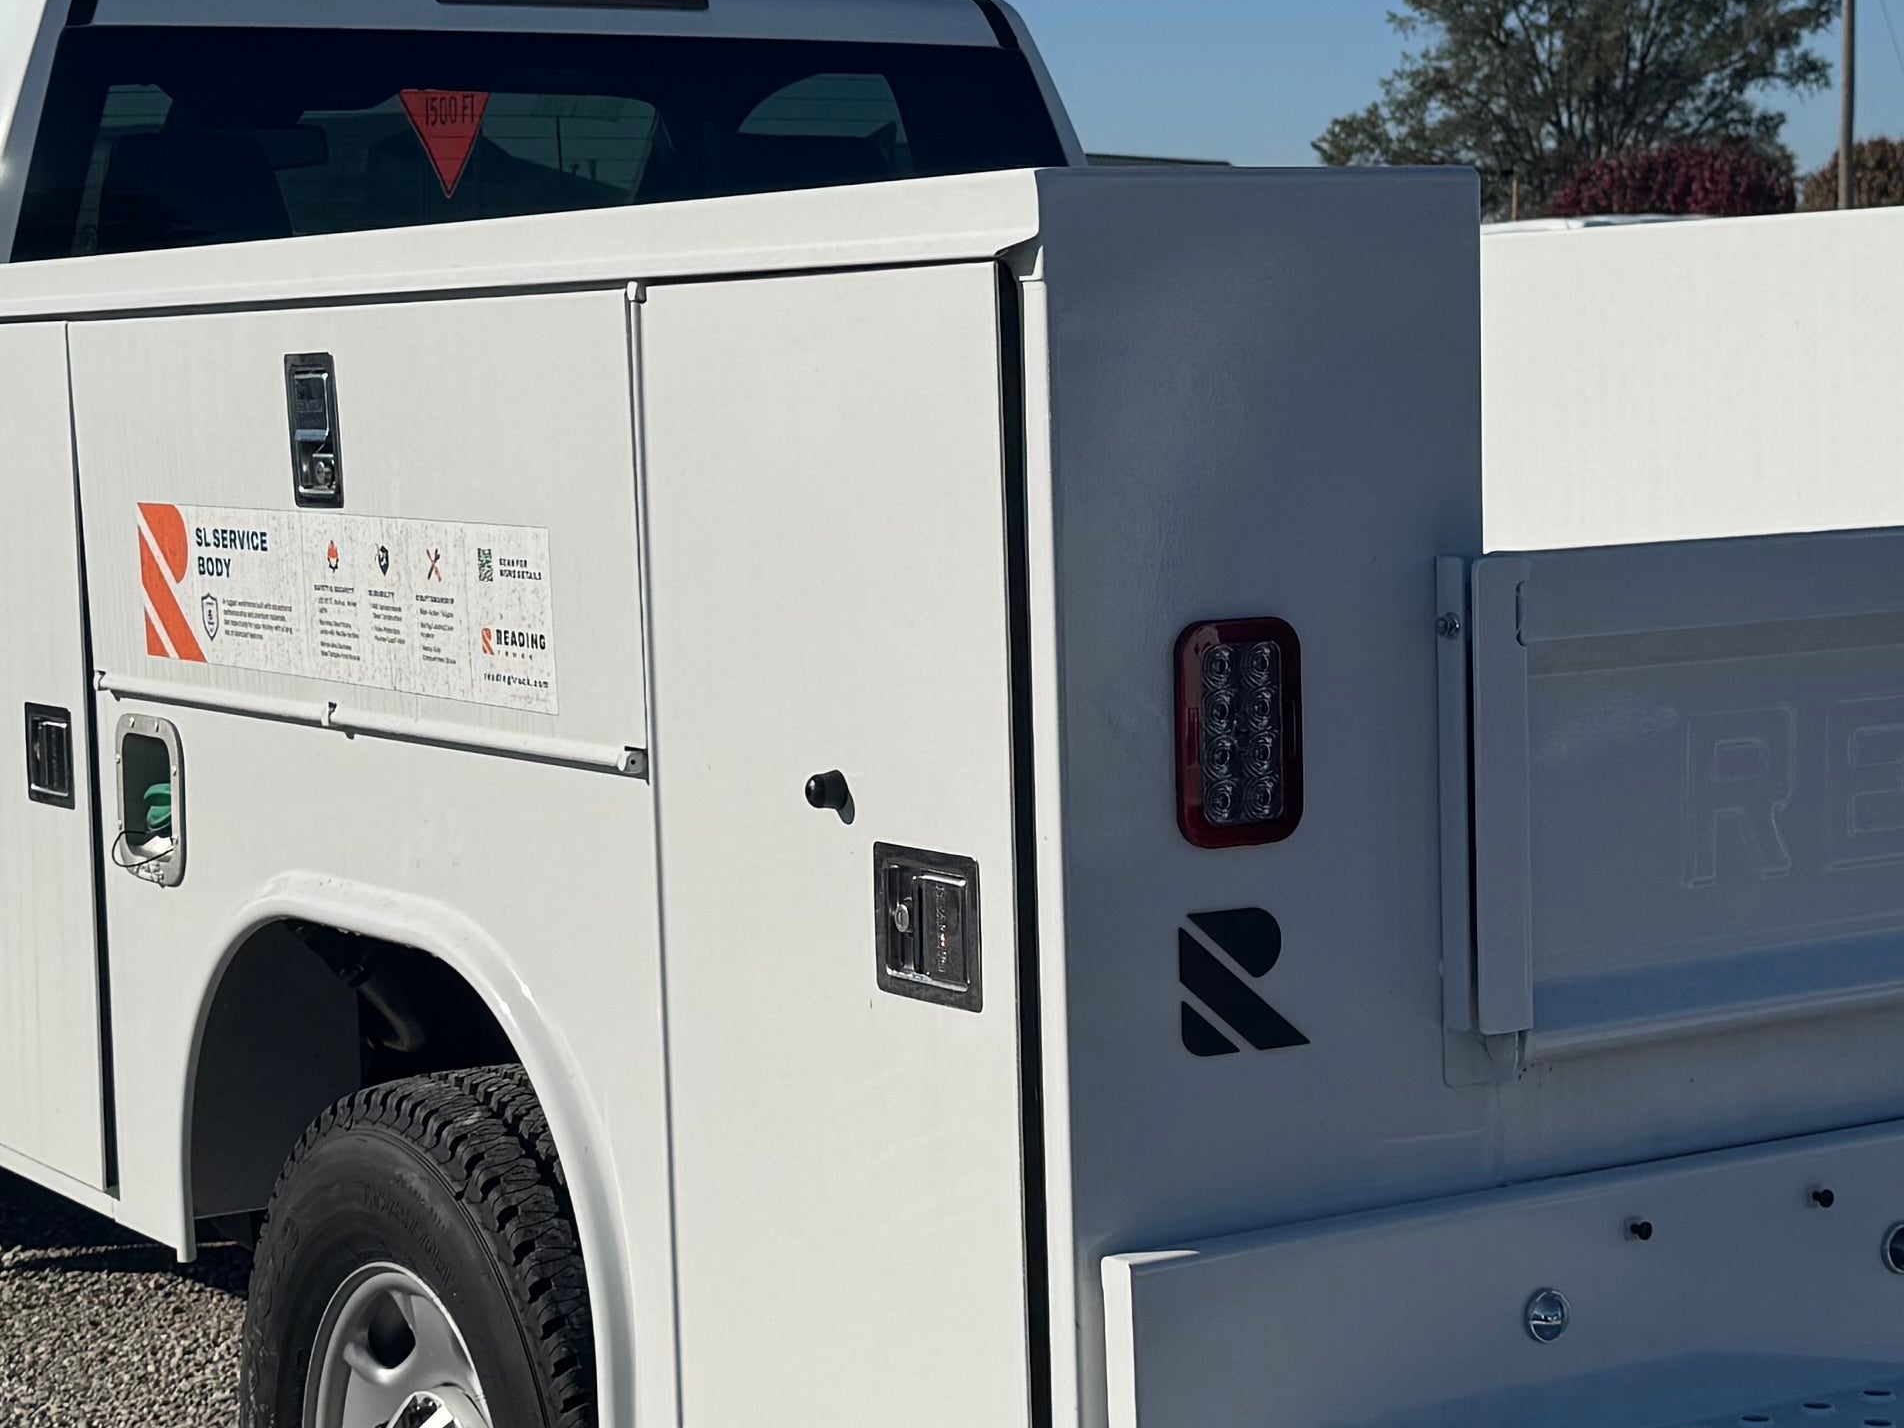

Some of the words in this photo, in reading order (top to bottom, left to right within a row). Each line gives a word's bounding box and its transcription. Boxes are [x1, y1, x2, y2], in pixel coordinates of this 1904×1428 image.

[195, 527, 211, 547] SL
[212, 528, 268, 552] SERVICE
[197, 555, 231, 579] BODY
[496, 628, 547, 651] READING
